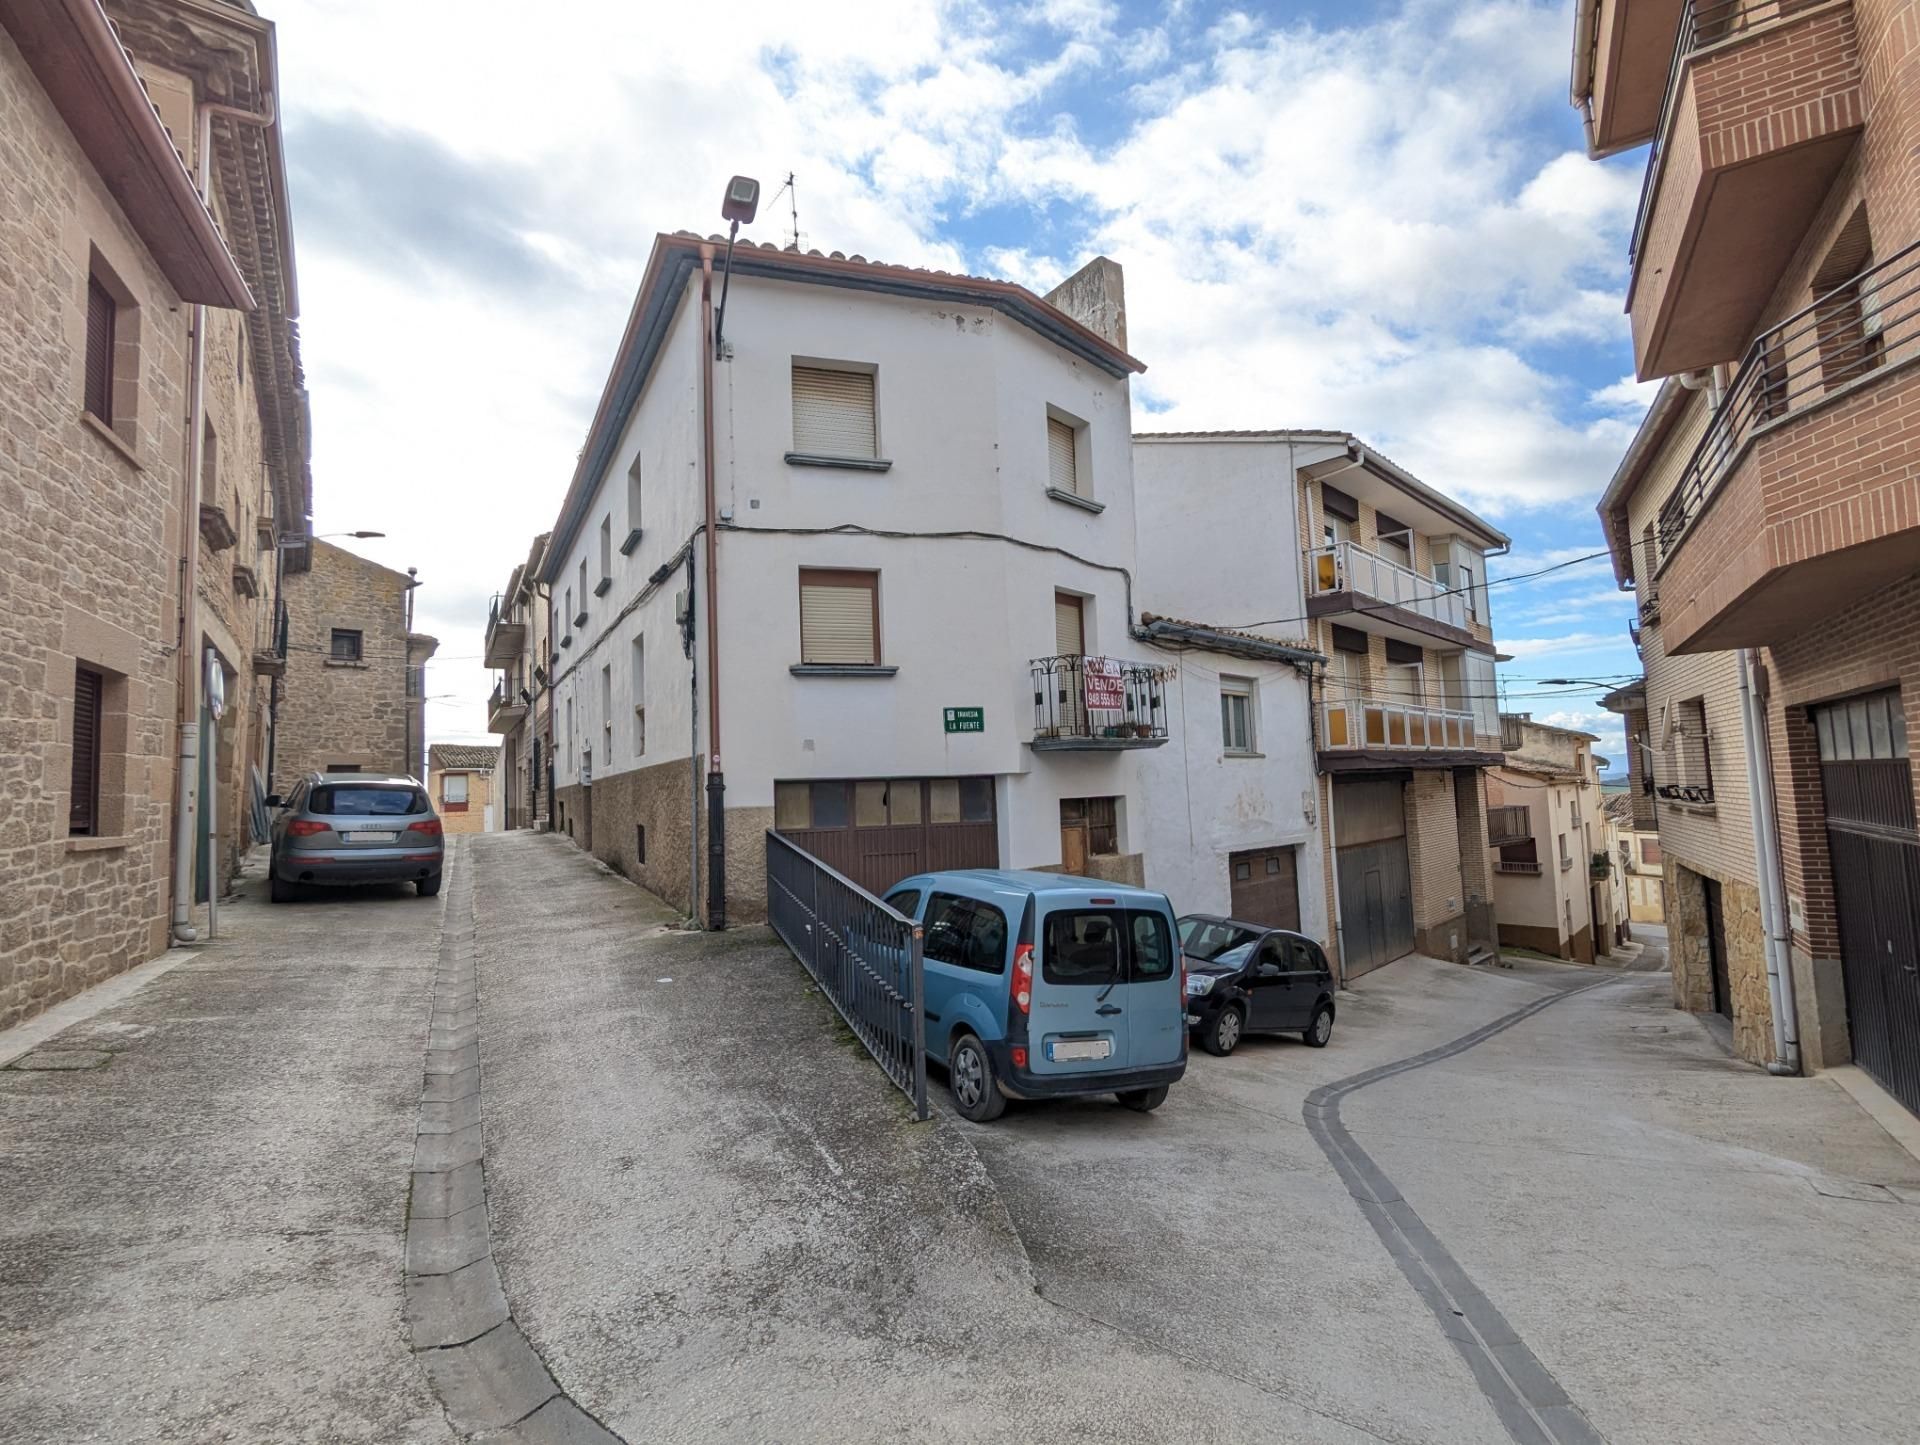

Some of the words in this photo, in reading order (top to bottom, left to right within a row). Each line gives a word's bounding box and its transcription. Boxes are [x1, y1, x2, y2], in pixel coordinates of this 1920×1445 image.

[1087, 677, 1124, 692] VENDE
[949, 722, 956, 730] LA
[959, 721, 980, 730] FUENTE
